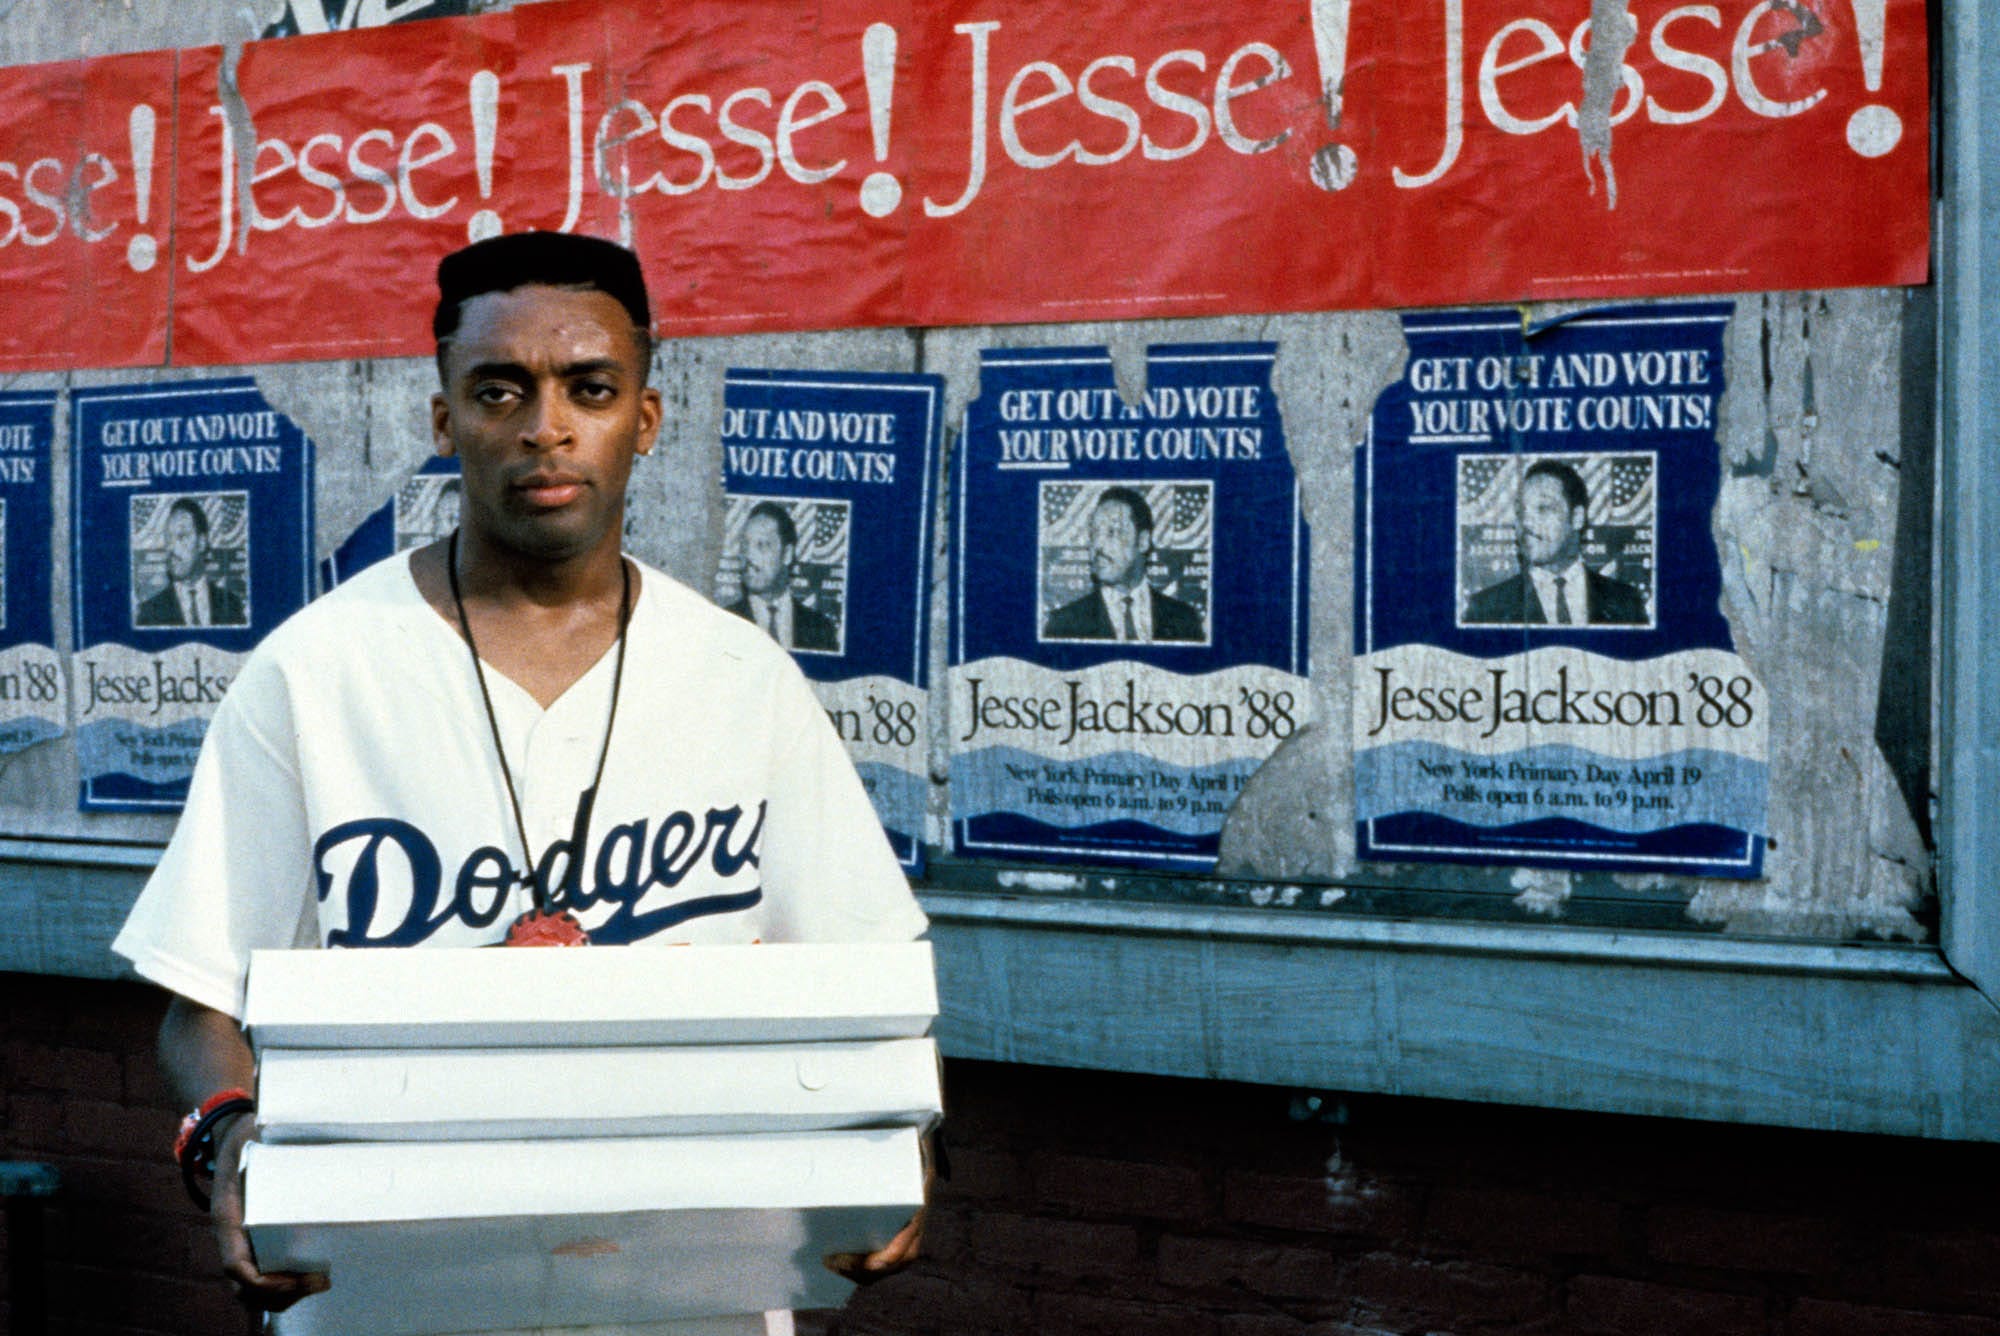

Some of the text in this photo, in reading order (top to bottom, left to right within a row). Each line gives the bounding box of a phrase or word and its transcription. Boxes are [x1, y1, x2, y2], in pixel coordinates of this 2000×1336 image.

[529, 22, 902, 234] Jesse!
[923, 0, 1357, 218] Jesse!
[186, 70, 502, 272] Jesse!
[1410, 350, 1710, 392] GET OUT AND VOTE
[1000, 389, 1053, 422] GET
[1057, 388, 1119, 421] OUT
[1182, 386, 1261, 419] VOTE
[1409, 394, 1712, 436] YOUR VOTE COUNTS!
[102, 411, 281, 447] GET OUT AND VOTE
[720, 407, 896, 445] OUT AND VOTE
[998, 427, 1262, 461] YOUR VOTE COUNTS!
[101, 445, 282, 480] YOUR VOTE COUNTS!
[727, 446, 896, 484] VOTE COUNTS!
[23, 660, 58, 702] '88
[82, 658, 236, 717] Jesse Jacks
[866, 695, 917, 747] '88
[962, 678, 1297, 746] Jesse Jackson '88
[1368, 666, 1754, 739] Jesse Jackson '88
[1006, 762, 1038, 781] New
[1042, 764, 1080, 784] York
[1083, 767, 1146, 789] Primary
[1151, 770, 1182, 793] Day
[1188, 771, 1228, 794] April
[1418, 758, 1702, 789] New York Primary Day April 19
[1026, 787, 1065, 806] Polls
[1105, 791, 1115, 808] 6
[1118, 795, 1153, 811] a.m.
[1176, 796, 1187, 811] 9
[1190, 799, 1228, 816] p.m.
[1442, 783, 1674, 813] Polls open 6 a.m. to 9 p.m.
